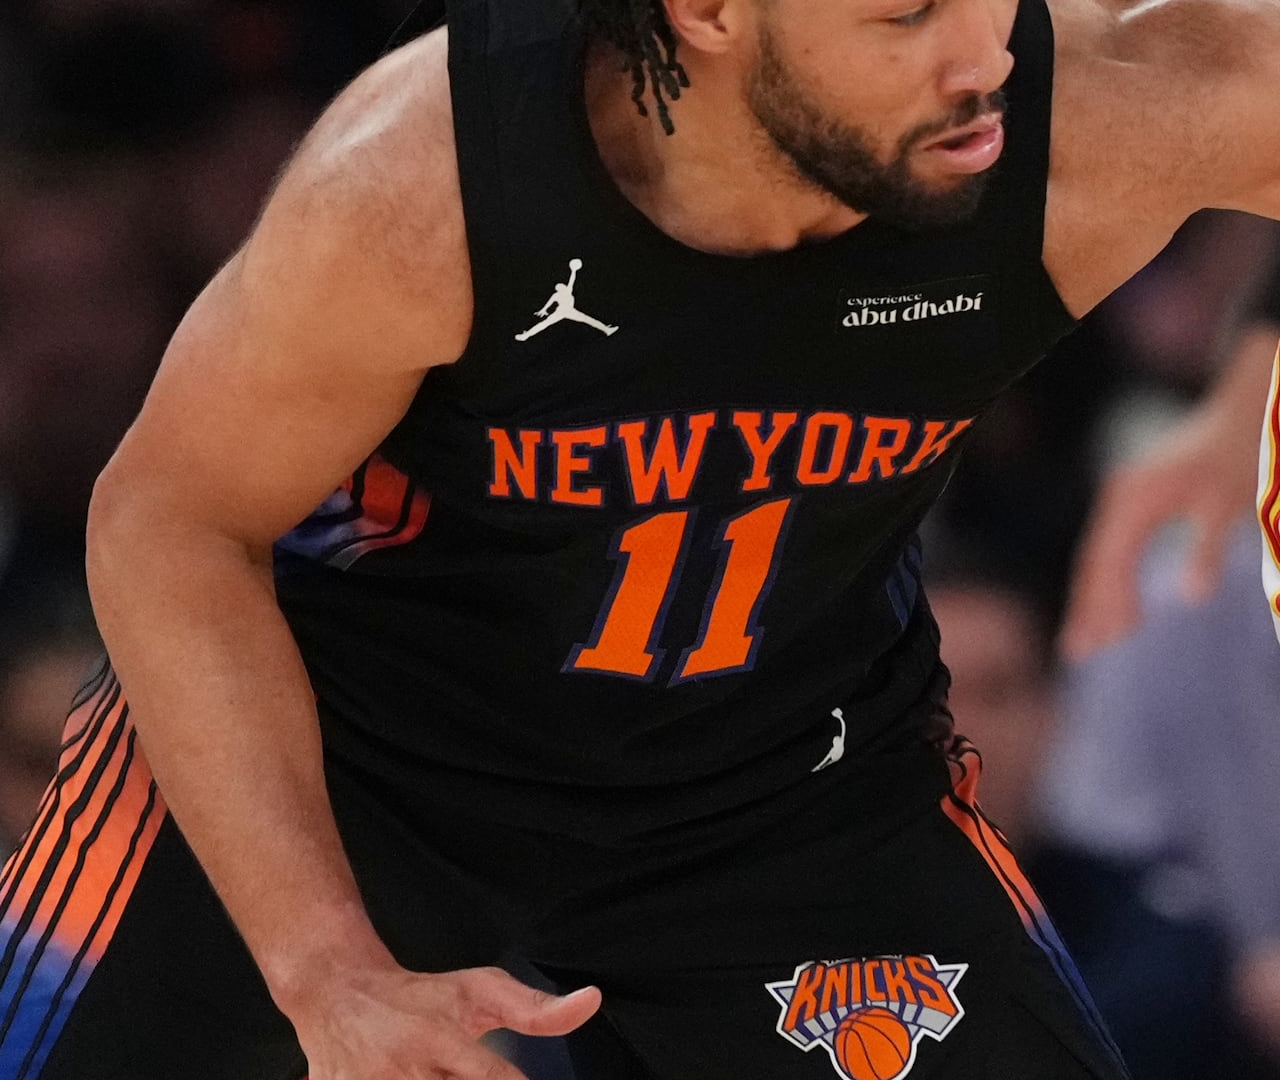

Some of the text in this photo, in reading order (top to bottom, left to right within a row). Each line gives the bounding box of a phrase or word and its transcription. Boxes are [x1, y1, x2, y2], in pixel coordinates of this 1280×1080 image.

[842, 307, 897, 327] abu
[847, 293, 923, 307] experience
[487, 412, 974, 506] NEW YORK
[563, 496, 793, 686] 11
[783, 955, 958, 1033] KNICKS
